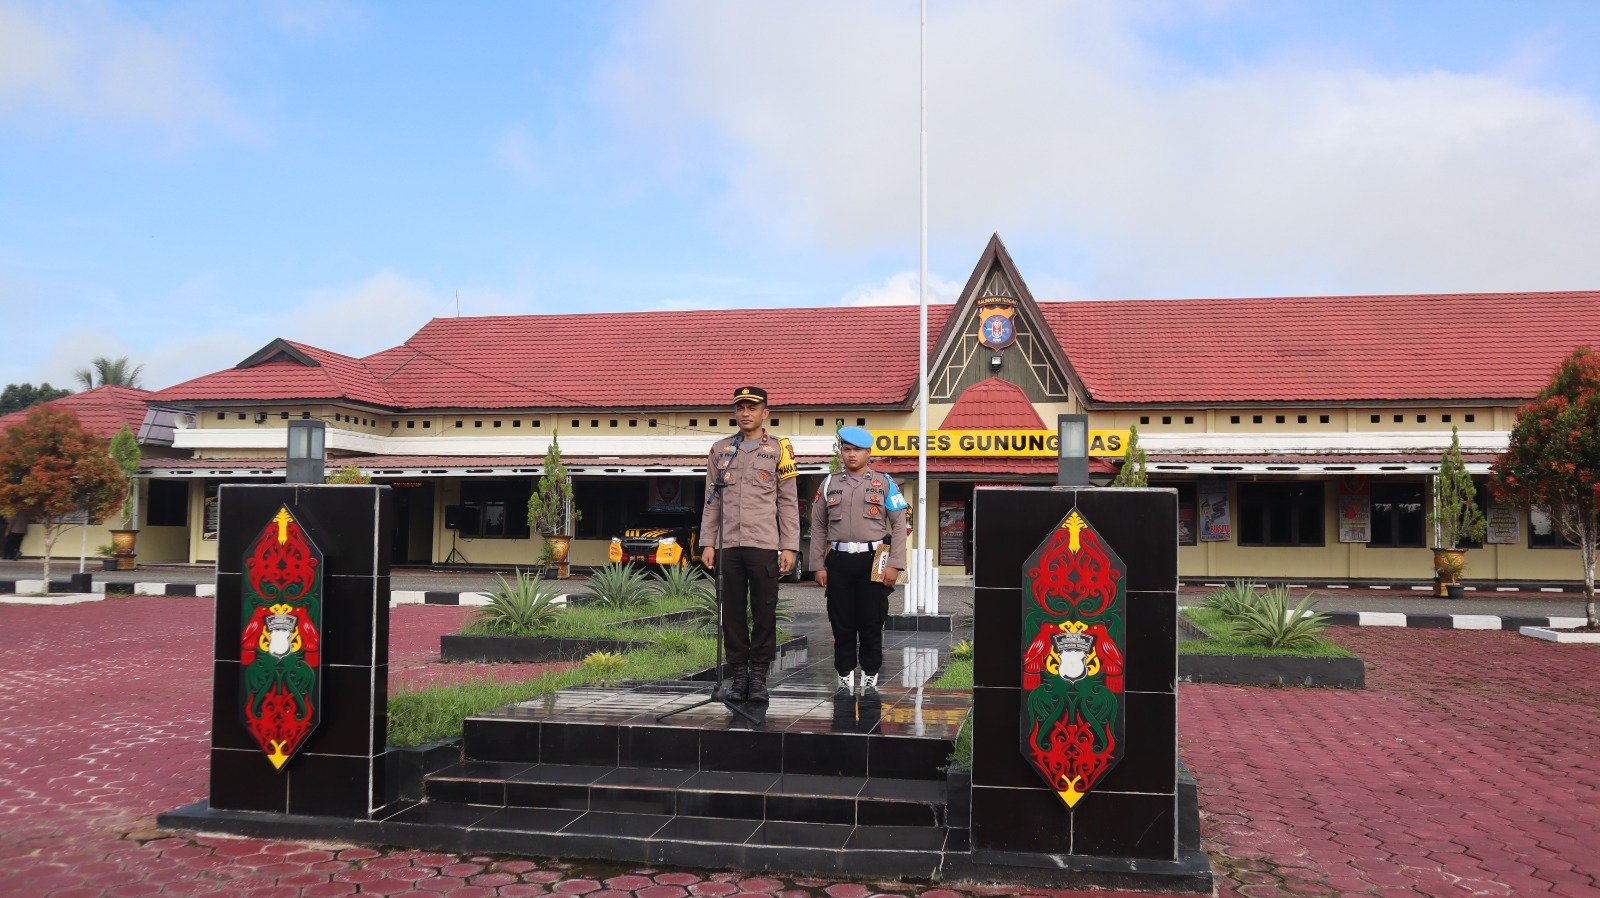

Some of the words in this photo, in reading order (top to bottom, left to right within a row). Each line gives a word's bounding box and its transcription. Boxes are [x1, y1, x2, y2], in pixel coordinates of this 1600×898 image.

[875, 435, 951, 451] OLRES
[959, 435, 1059, 451] GUNUNG
[1090, 435, 1121, 451] AS
[757, 453, 776, 461] POLRI
